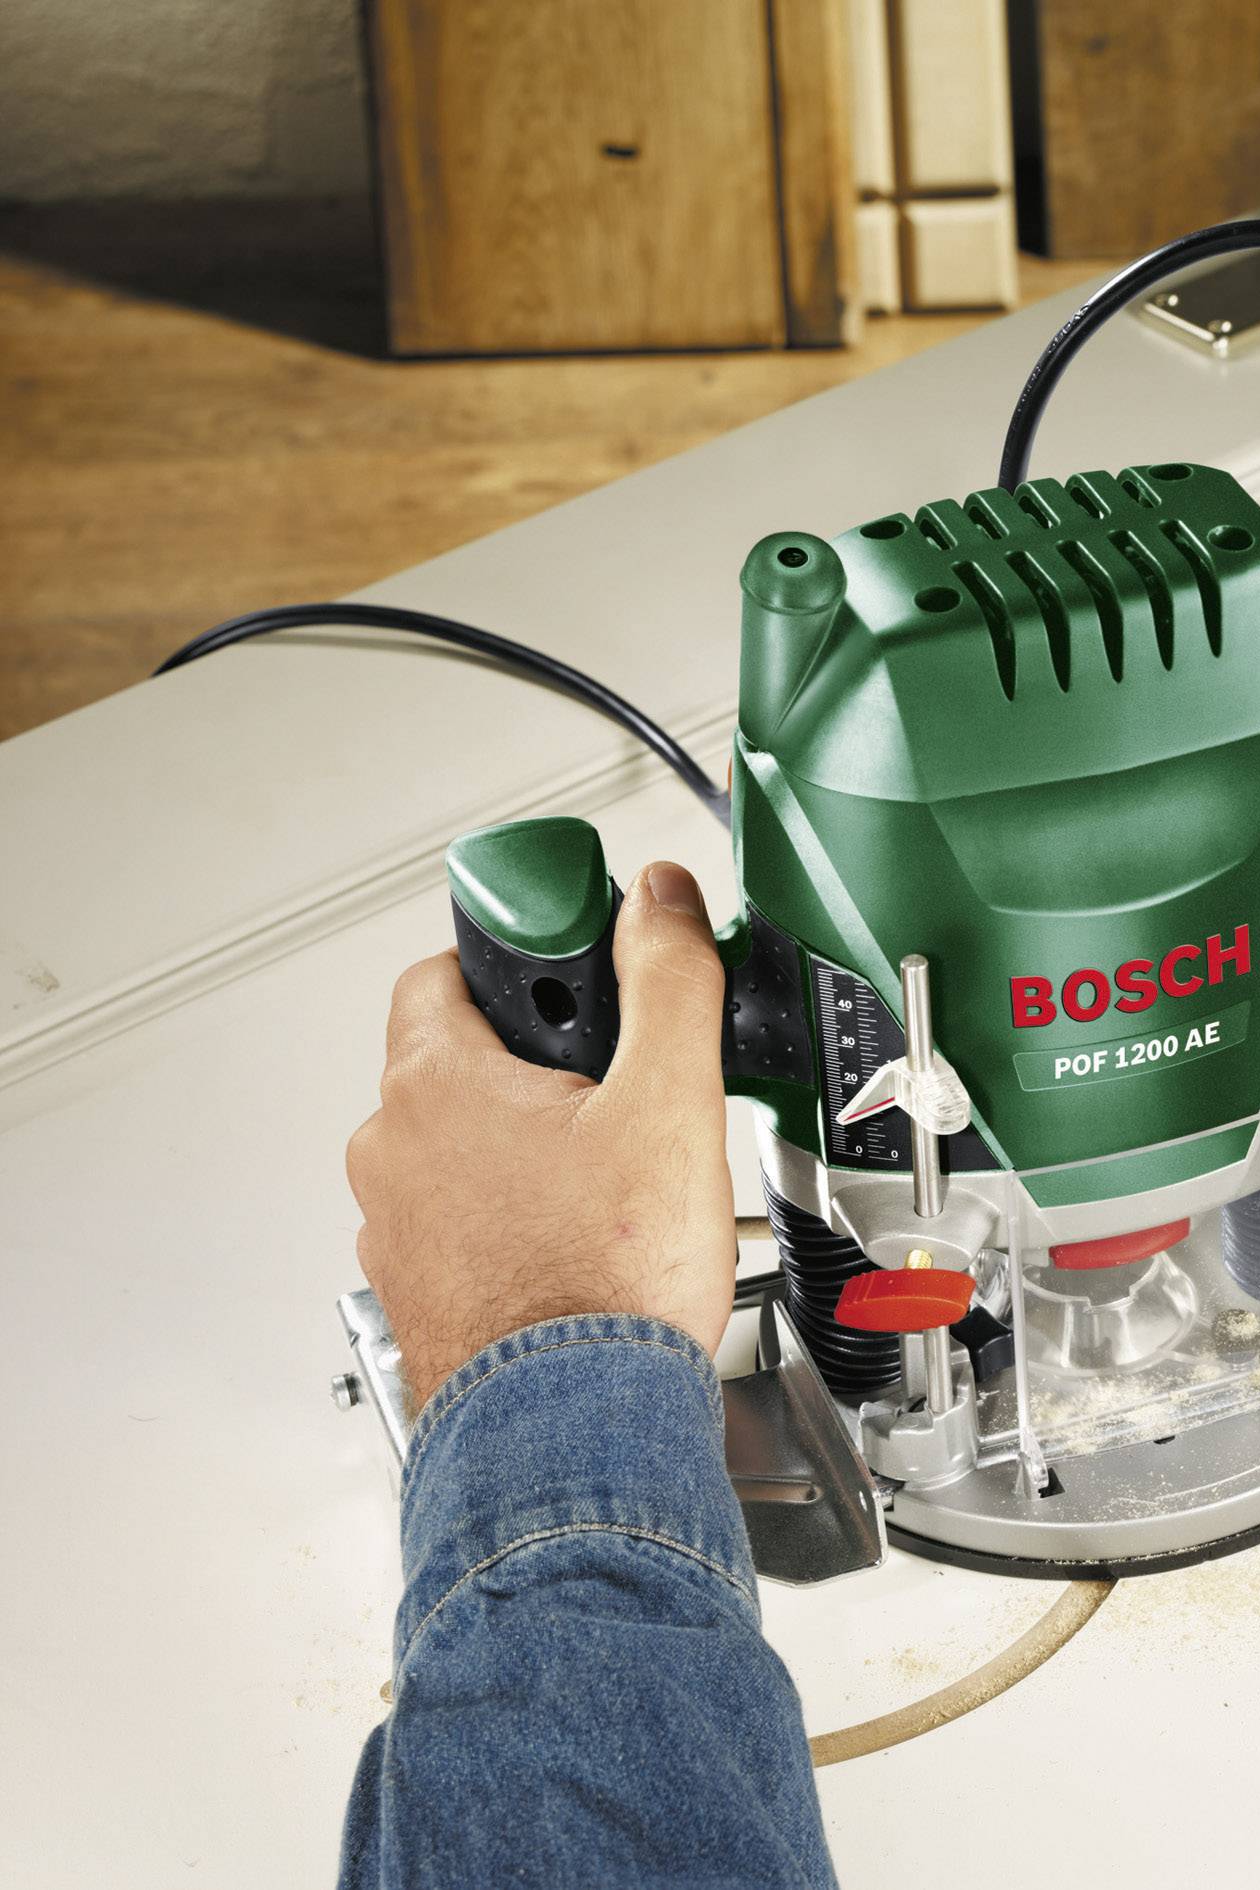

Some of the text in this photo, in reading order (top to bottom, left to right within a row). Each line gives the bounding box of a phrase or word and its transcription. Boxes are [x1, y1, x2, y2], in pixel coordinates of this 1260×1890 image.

[1009, 923, 1251, 1028] BOSCH
[838, 999, 853, 1010] 40
[841, 1036, 856, 1047] 30
[1054, 1020, 1221, 1080] POF 1200 AE
[844, 1072, 858, 1083] 20
[855, 1145, 863, 1154] 0
[890, 1150, 899, 1159] 0
